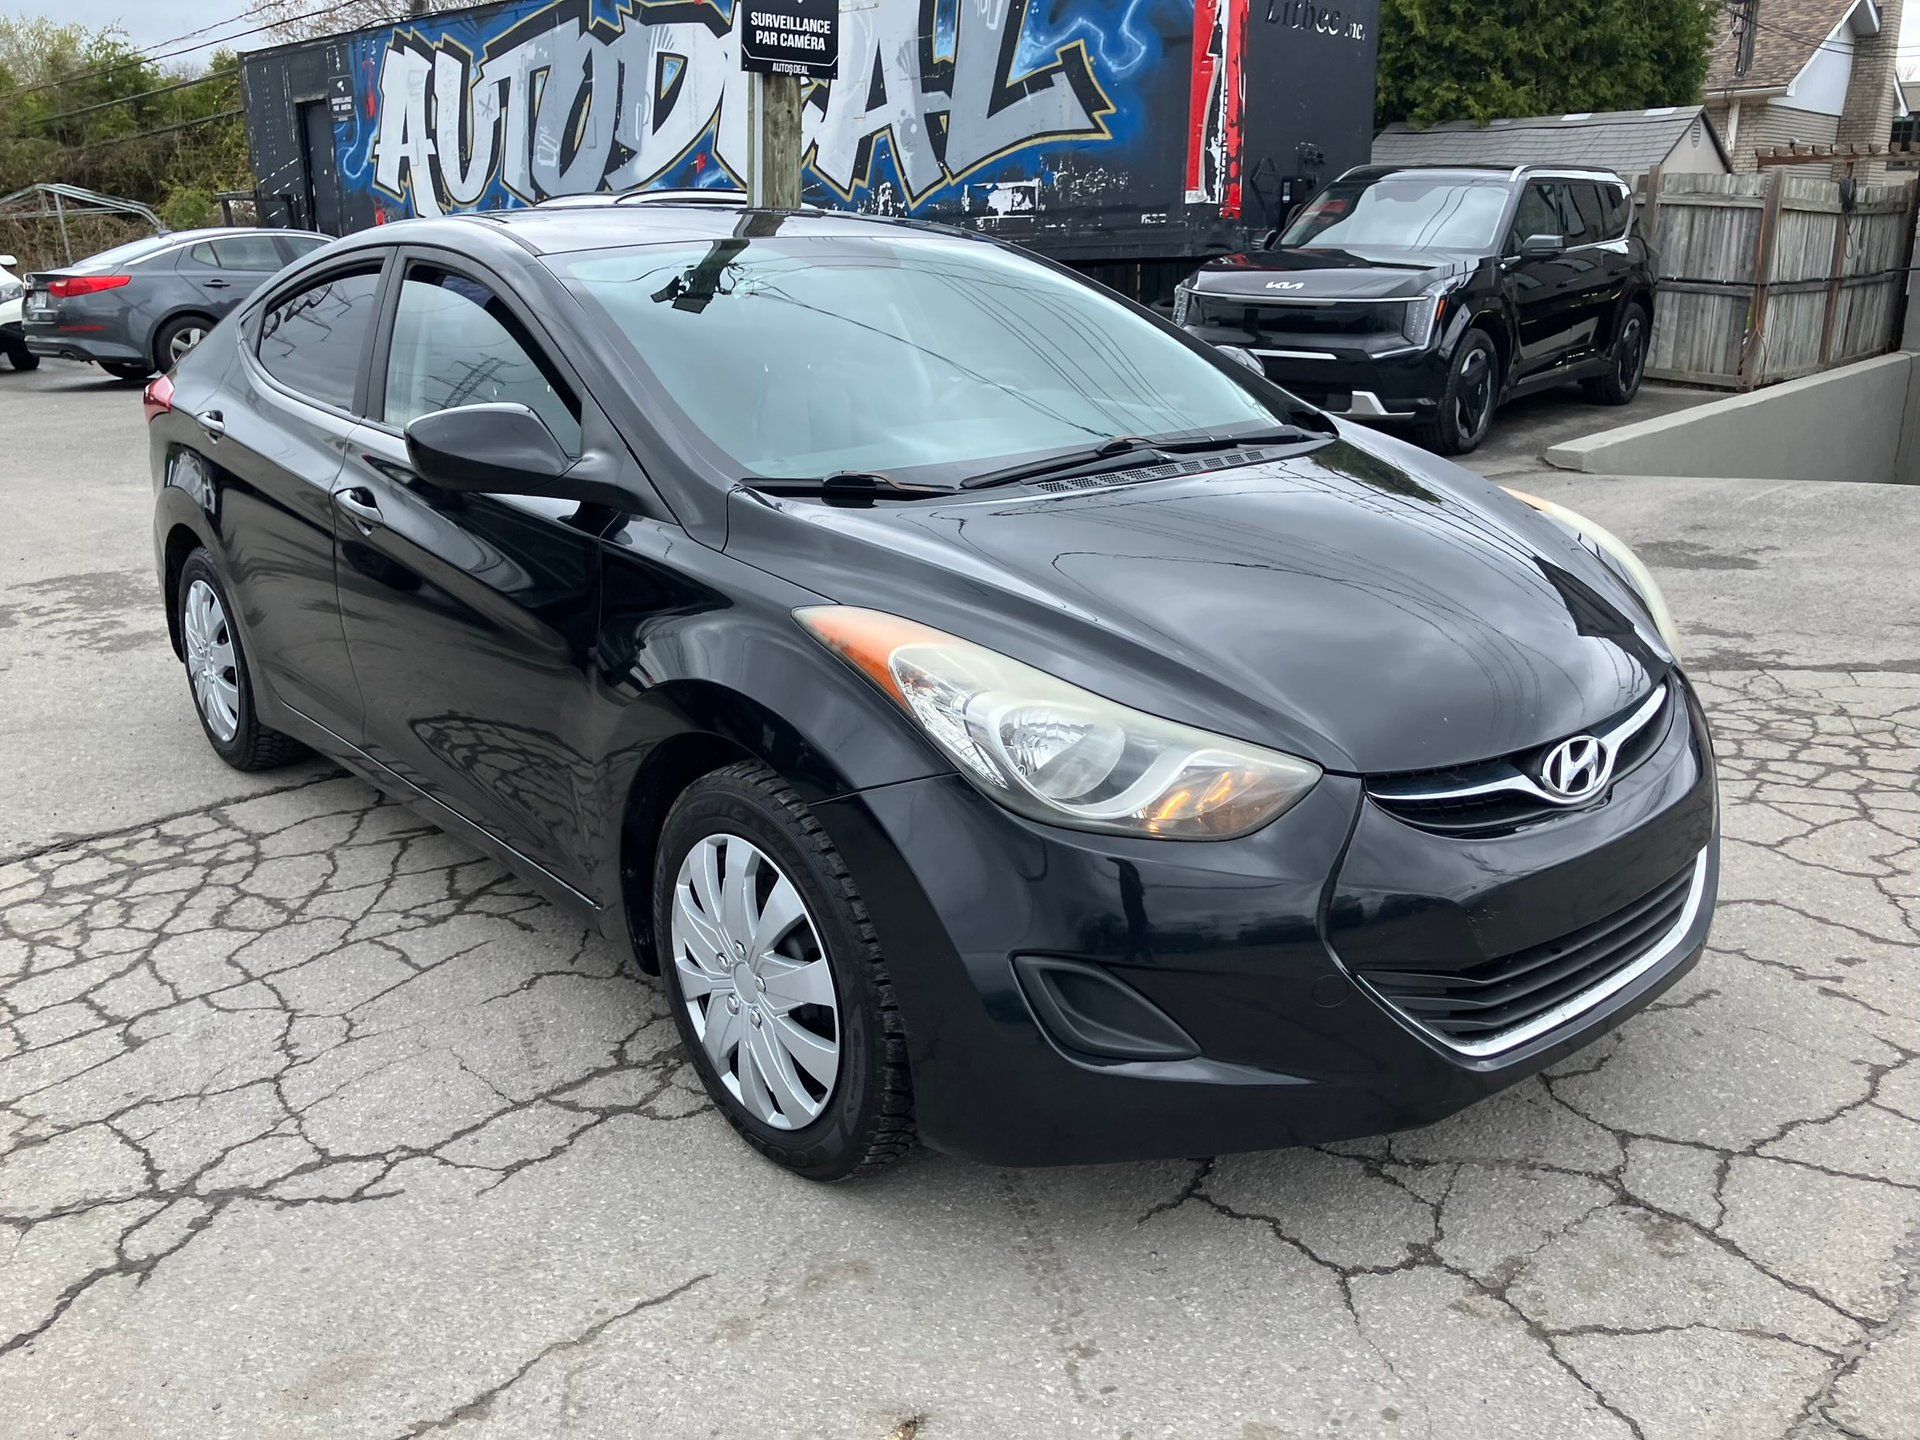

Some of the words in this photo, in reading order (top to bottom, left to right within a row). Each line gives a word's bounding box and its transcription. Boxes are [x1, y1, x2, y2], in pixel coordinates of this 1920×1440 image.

[751, 11, 831, 34] SURVEILLANCE
[755, 30, 778, 46] PAR
[780, 33, 826, 51] CAMÉRA
[373, 0, 1110, 217] AUTODAL
